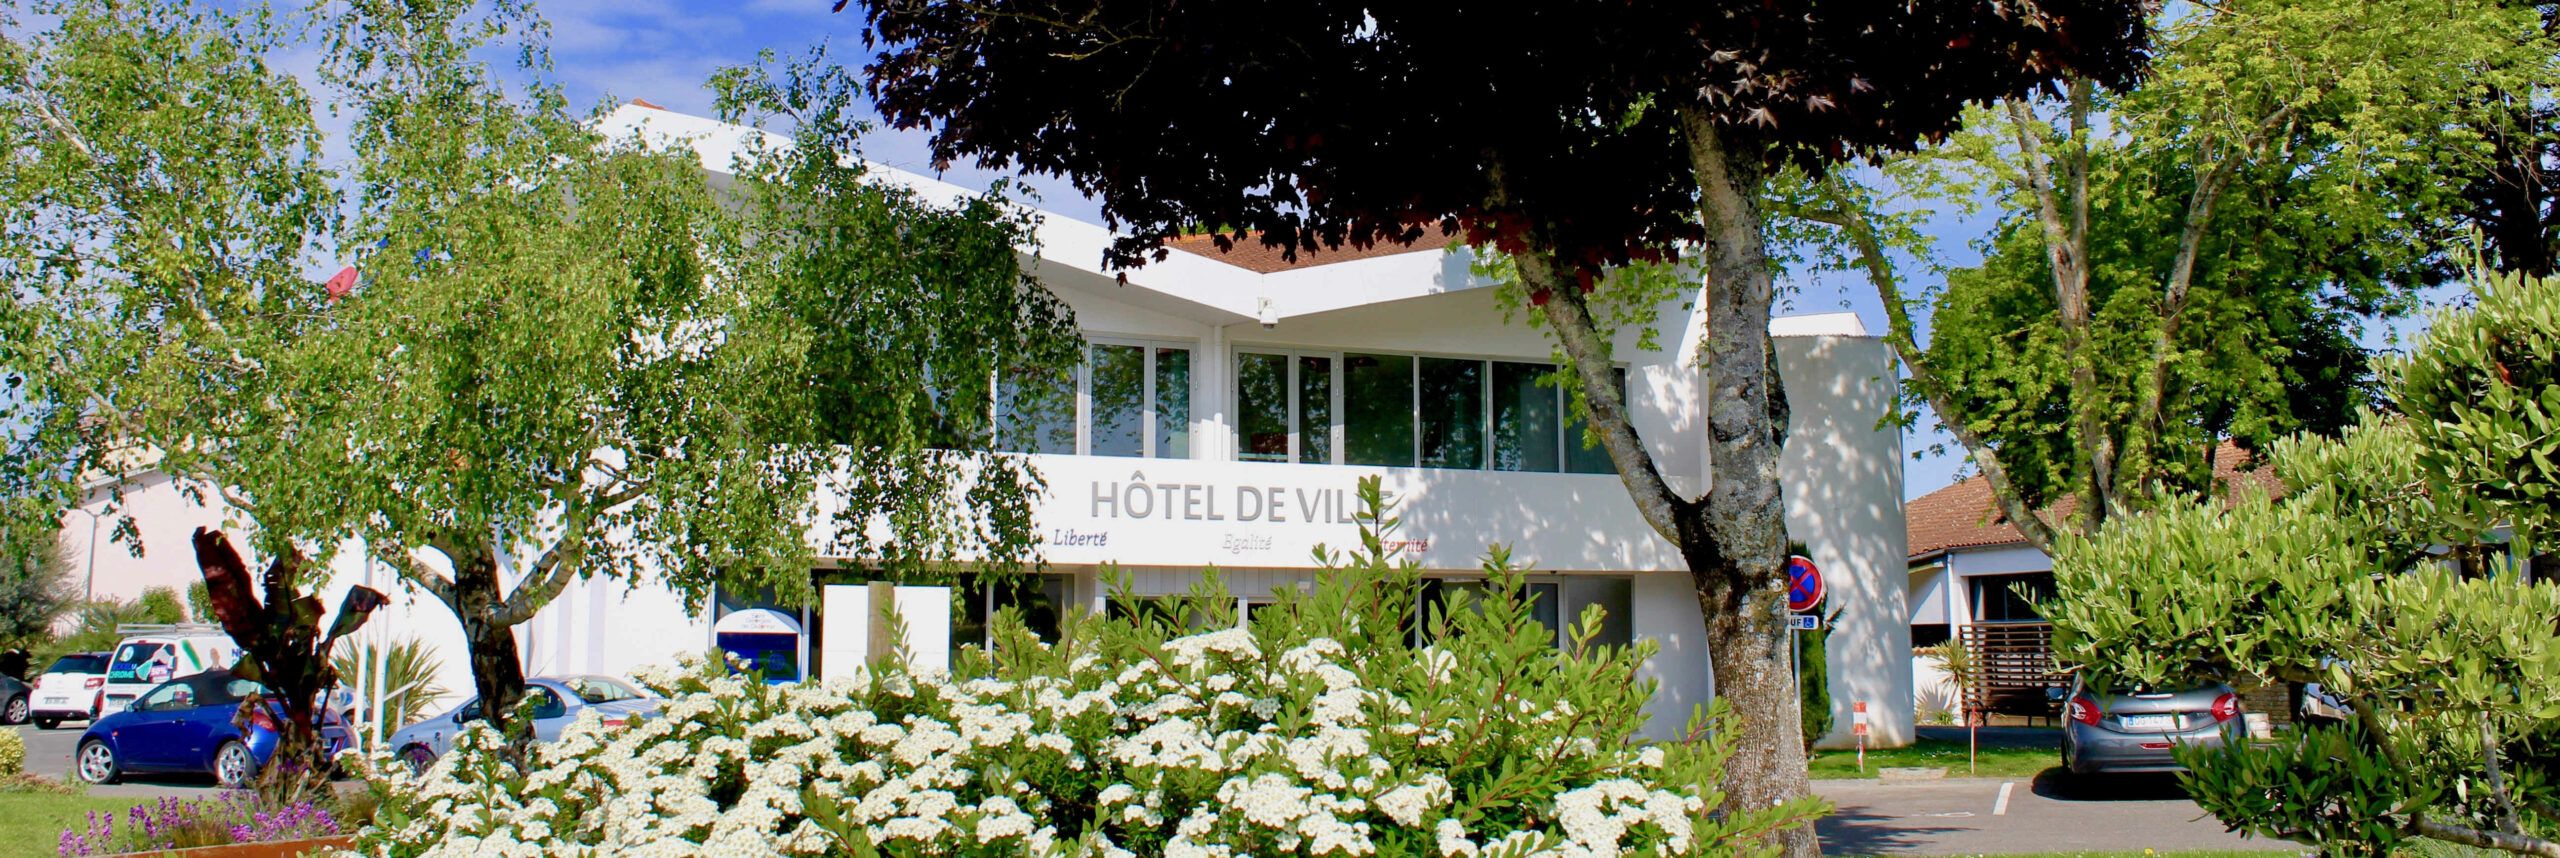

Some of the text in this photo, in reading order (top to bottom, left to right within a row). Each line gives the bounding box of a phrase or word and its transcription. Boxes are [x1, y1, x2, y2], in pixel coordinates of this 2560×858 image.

[1091, 470, 1225, 520] HÔTEL
[1236, 485, 1286, 522] DE
[1052, 528, 1108, 546] Liberté
[1222, 532, 1273, 554] Egalité
